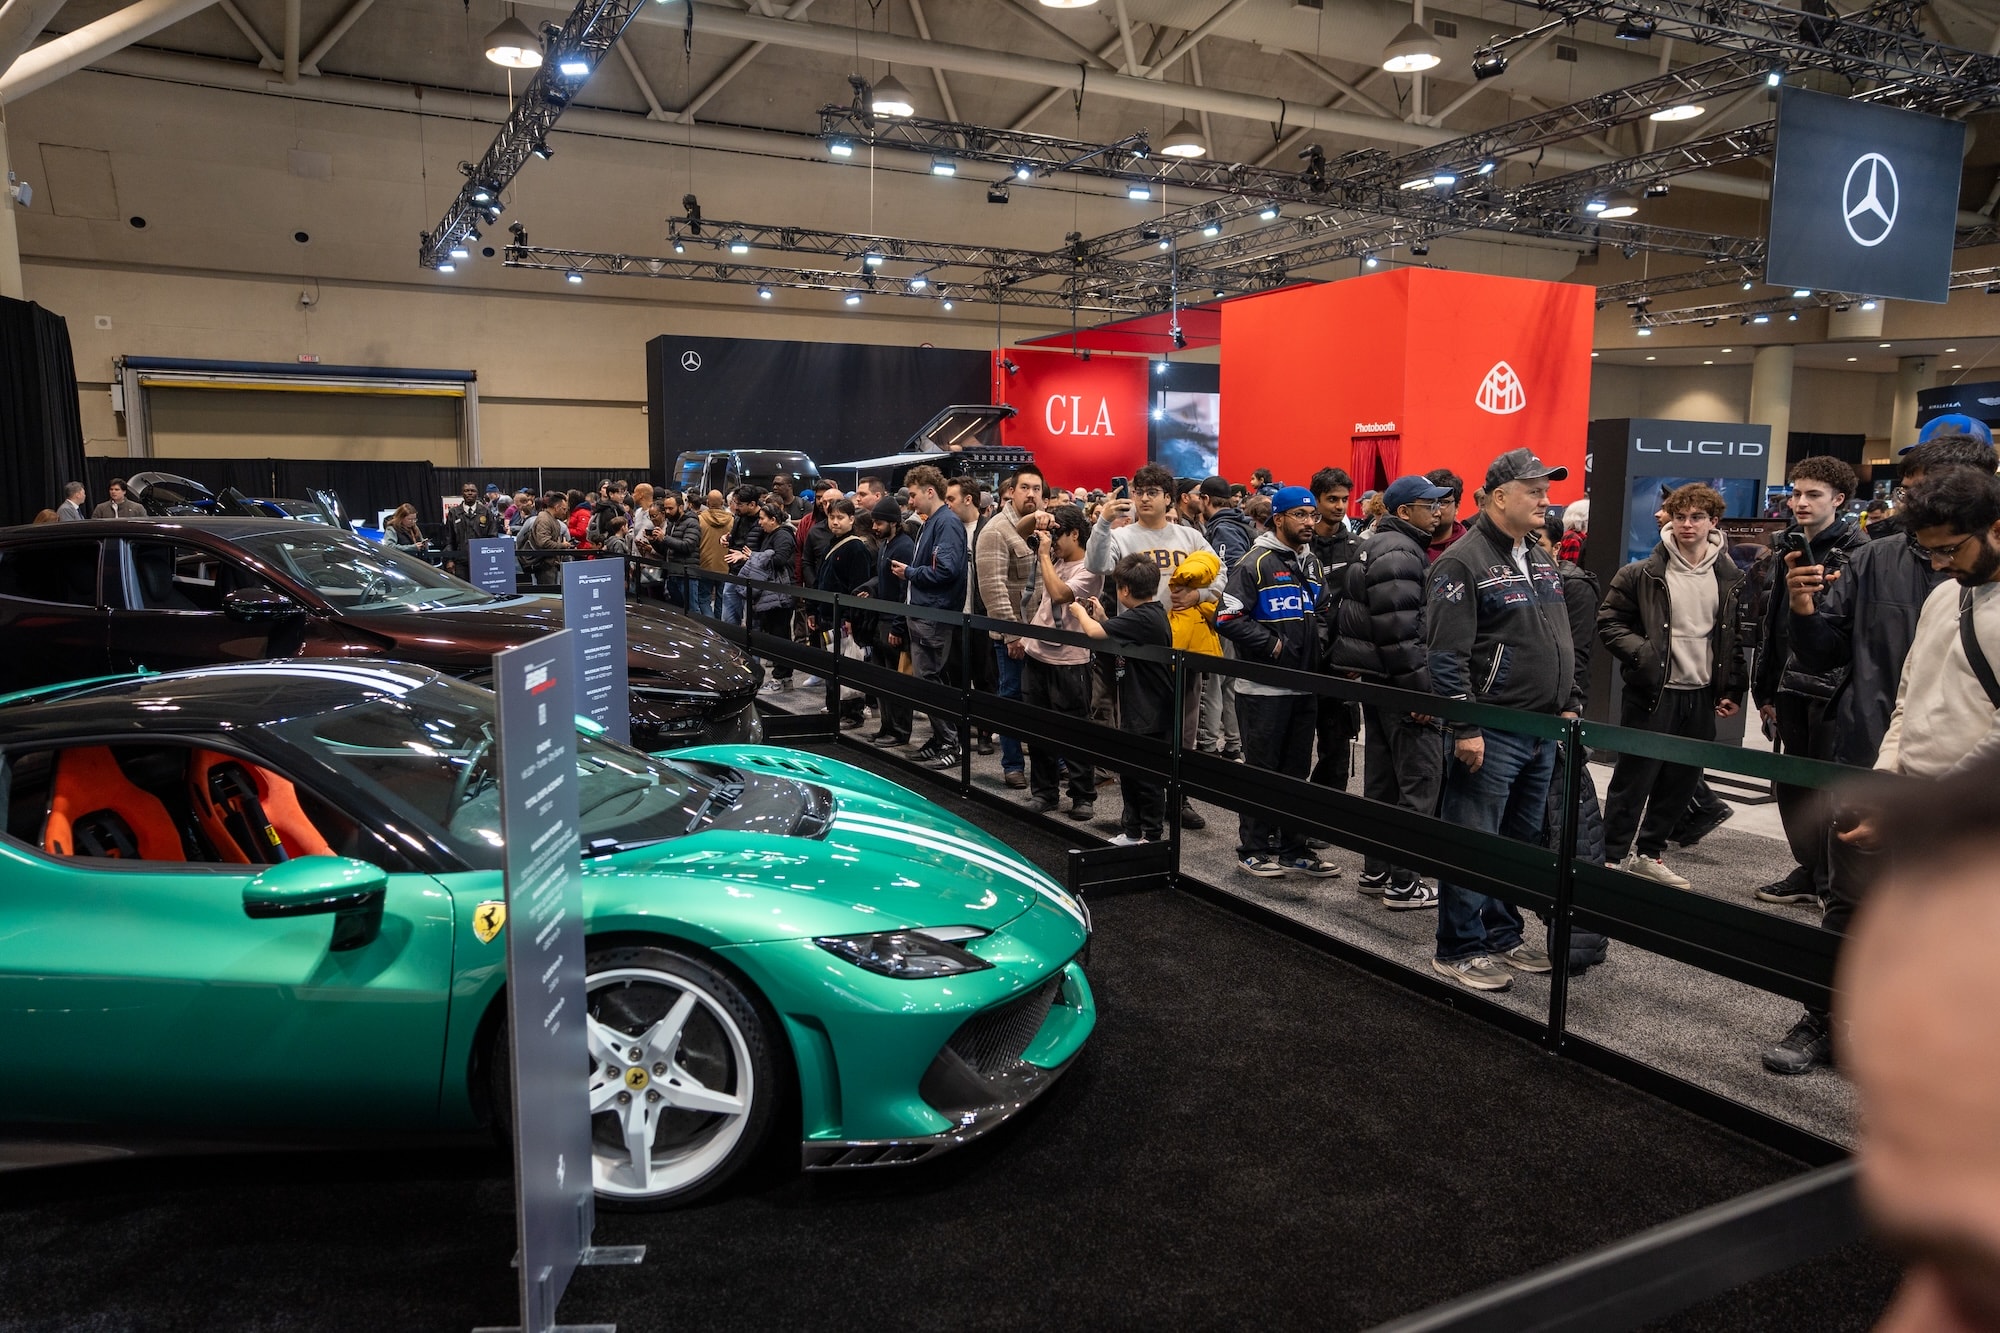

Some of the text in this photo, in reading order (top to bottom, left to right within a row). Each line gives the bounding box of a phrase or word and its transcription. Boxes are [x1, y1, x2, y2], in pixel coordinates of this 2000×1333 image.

[1045, 394, 1116, 436] CLA
[1355, 422, 1395, 432] Photobooth
[1636, 438, 1763, 456] LUCID
